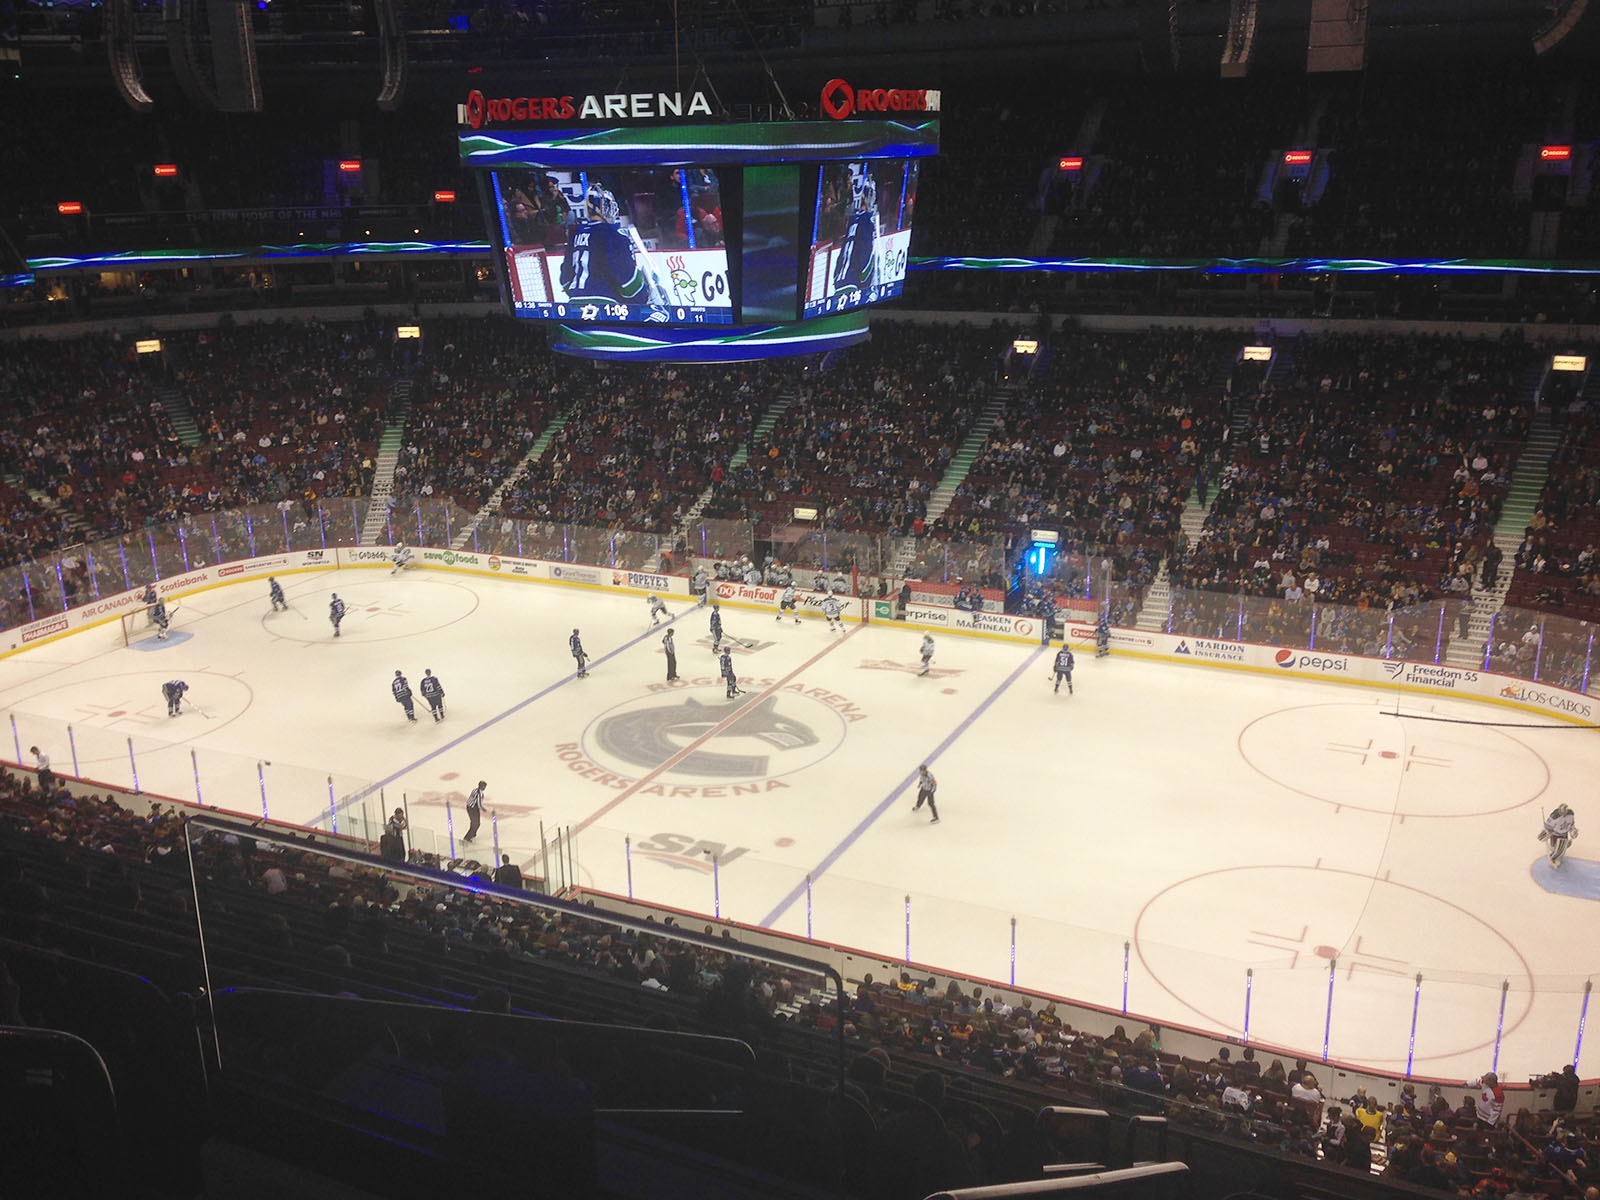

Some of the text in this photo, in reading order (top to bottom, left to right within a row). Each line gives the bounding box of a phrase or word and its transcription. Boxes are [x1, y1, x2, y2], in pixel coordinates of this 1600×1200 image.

[488, 96, 575, 121] ROGERS
[580, 91, 712, 120] ARENA
[857, 88, 926, 112] ROGERS
[557, 305, 566, 317] 0
[604, 304, 629, 317] 1:06
[676, 308, 685, 320] 0
[695, 314, 703, 322] 11
[424, 551, 442, 560] save
[455, 553, 479, 564] foods
[160, 573, 208, 593] Scotiabank
[628, 572, 669, 587] POPEYE'S
[82, 595, 134, 619] AIR CANADA
[956, 619, 1011, 633] MARTINEAU
[1195, 640, 1245, 654] MARDON
[1060, 656, 1068, 667] 51
[1194, 650, 1245, 662] INSURANCE
[1299, 655, 1348, 671] pepsi
[1406, 673, 1456, 688] Financial
[1413, 665, 1479, 682] Freedom 55
[784, 682, 869, 724] ARENA
[554, 741, 791, 799] ROGERS ARENA
